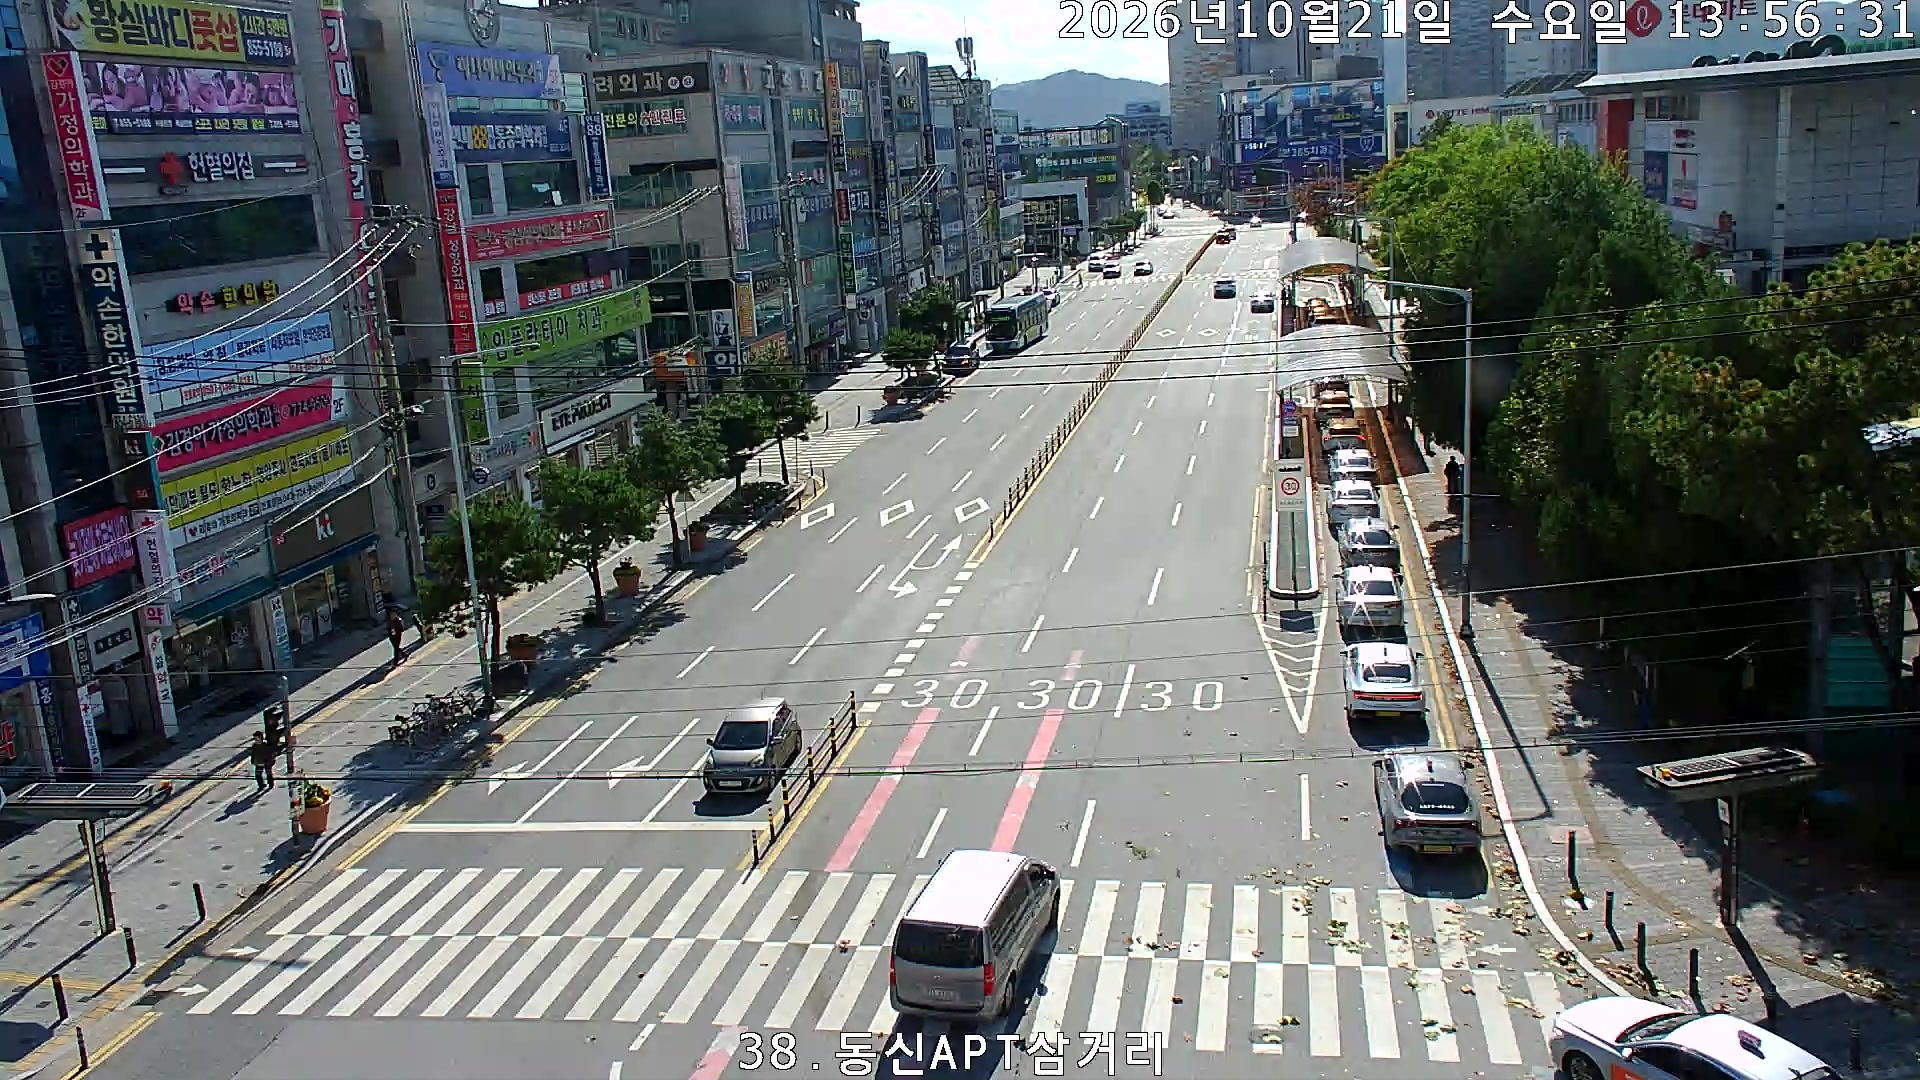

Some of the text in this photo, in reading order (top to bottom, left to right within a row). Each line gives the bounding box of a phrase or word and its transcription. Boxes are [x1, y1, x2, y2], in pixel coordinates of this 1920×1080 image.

[56, 91, 95, 203] 가정의학과
[188, 151, 256, 183] 헌혈의집
[315, 511, 335, 540] kt
[147, 607, 162, 624] 약
[902, 679, 987, 710] 30
[1017, 680, 1102, 710] 30
[1141, 681, 1223, 712] 30
